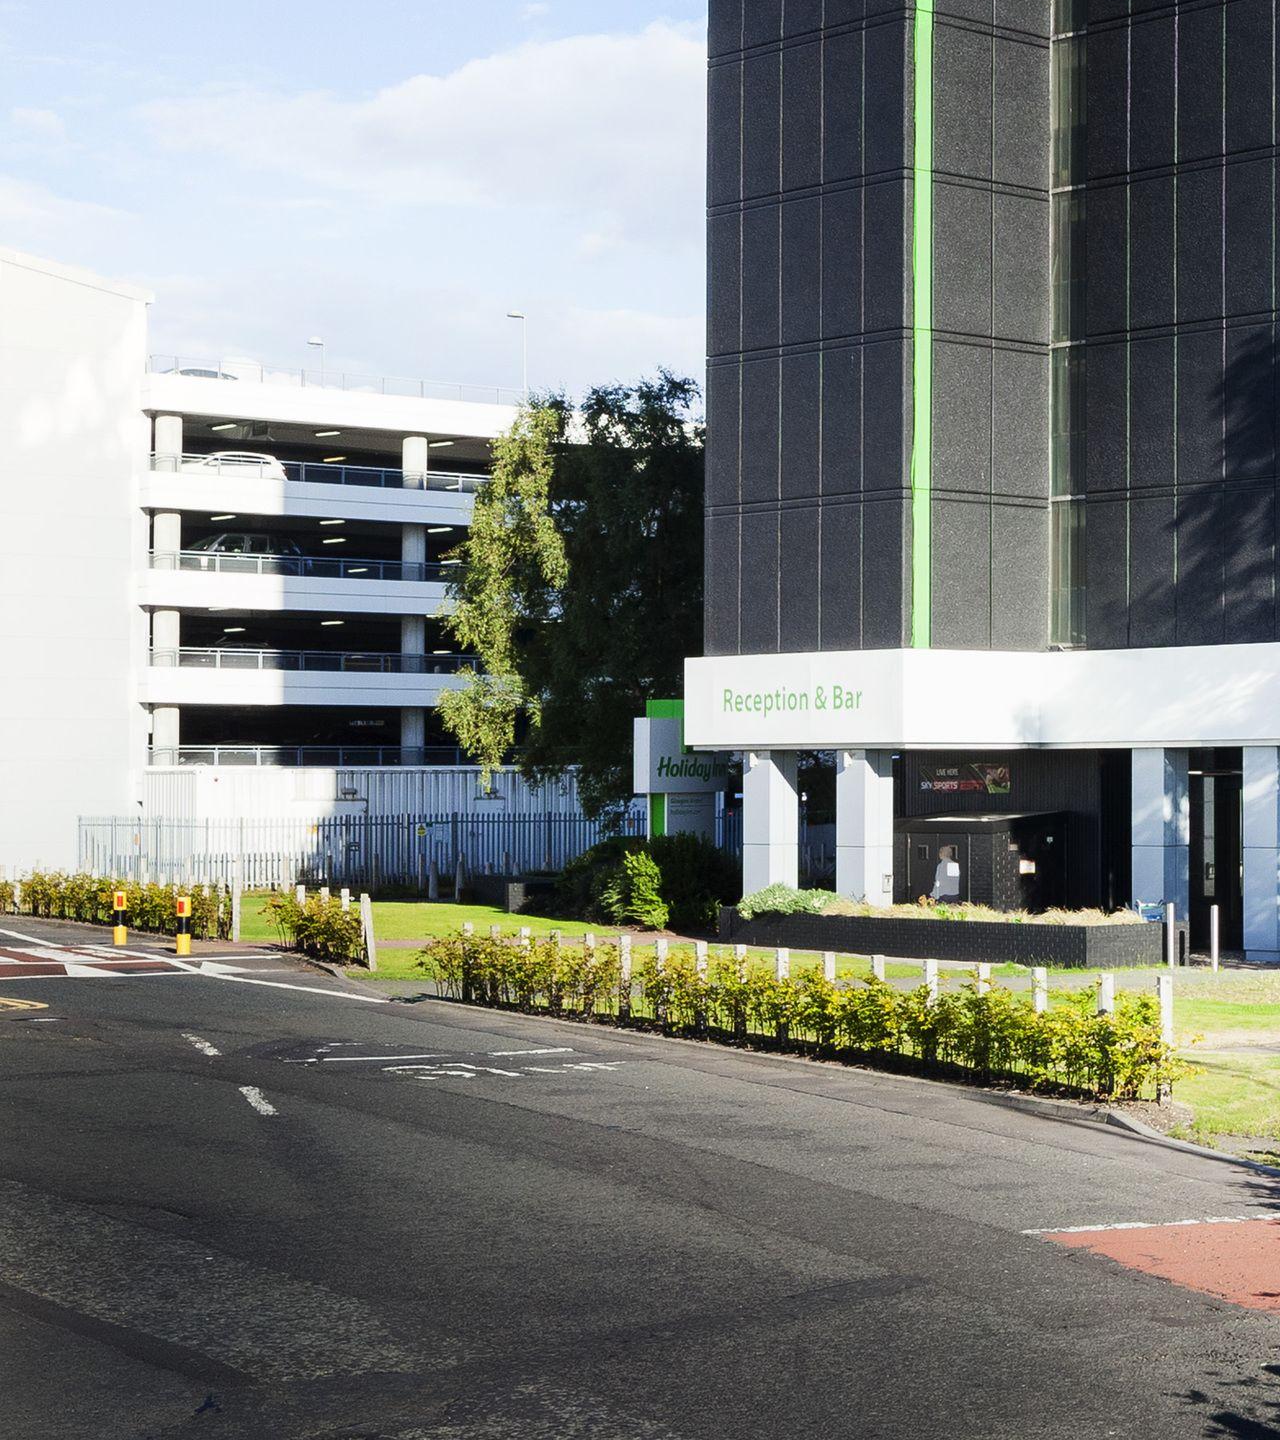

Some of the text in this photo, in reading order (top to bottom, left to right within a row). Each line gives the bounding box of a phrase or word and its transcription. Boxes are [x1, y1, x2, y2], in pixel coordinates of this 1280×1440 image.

[723, 685, 863, 719] Reception & Bar
[656, 755, 711, 783] Holiday
[933, 781, 958, 791] SPORTS
